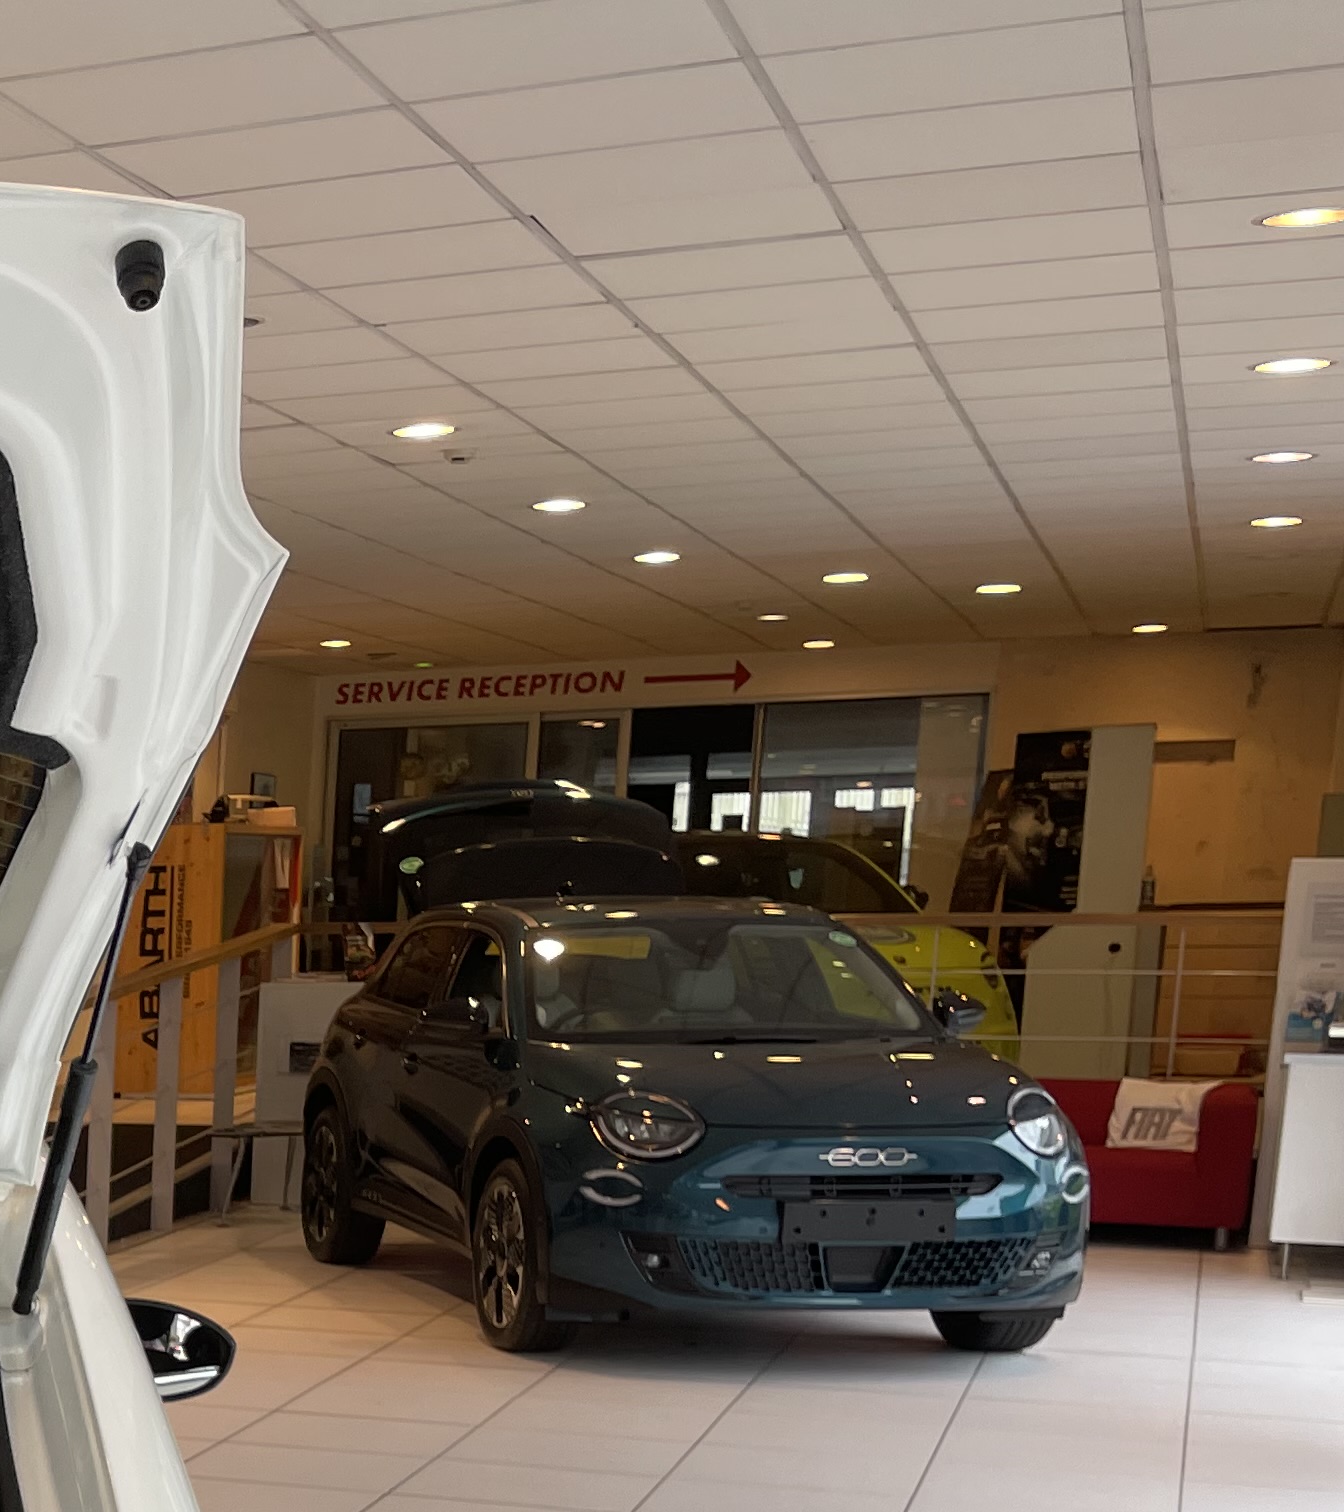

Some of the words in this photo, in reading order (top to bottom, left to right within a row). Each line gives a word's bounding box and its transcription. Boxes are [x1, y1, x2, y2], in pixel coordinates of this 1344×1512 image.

[335, 678, 450, 705] SERVICE
[457, 670, 626, 699] RECEPTION
[175, 864, 186, 958] ERFORMANCE
[1120, 1107, 1182, 1140] FIAT
[823, 1147, 914, 1167] 600
